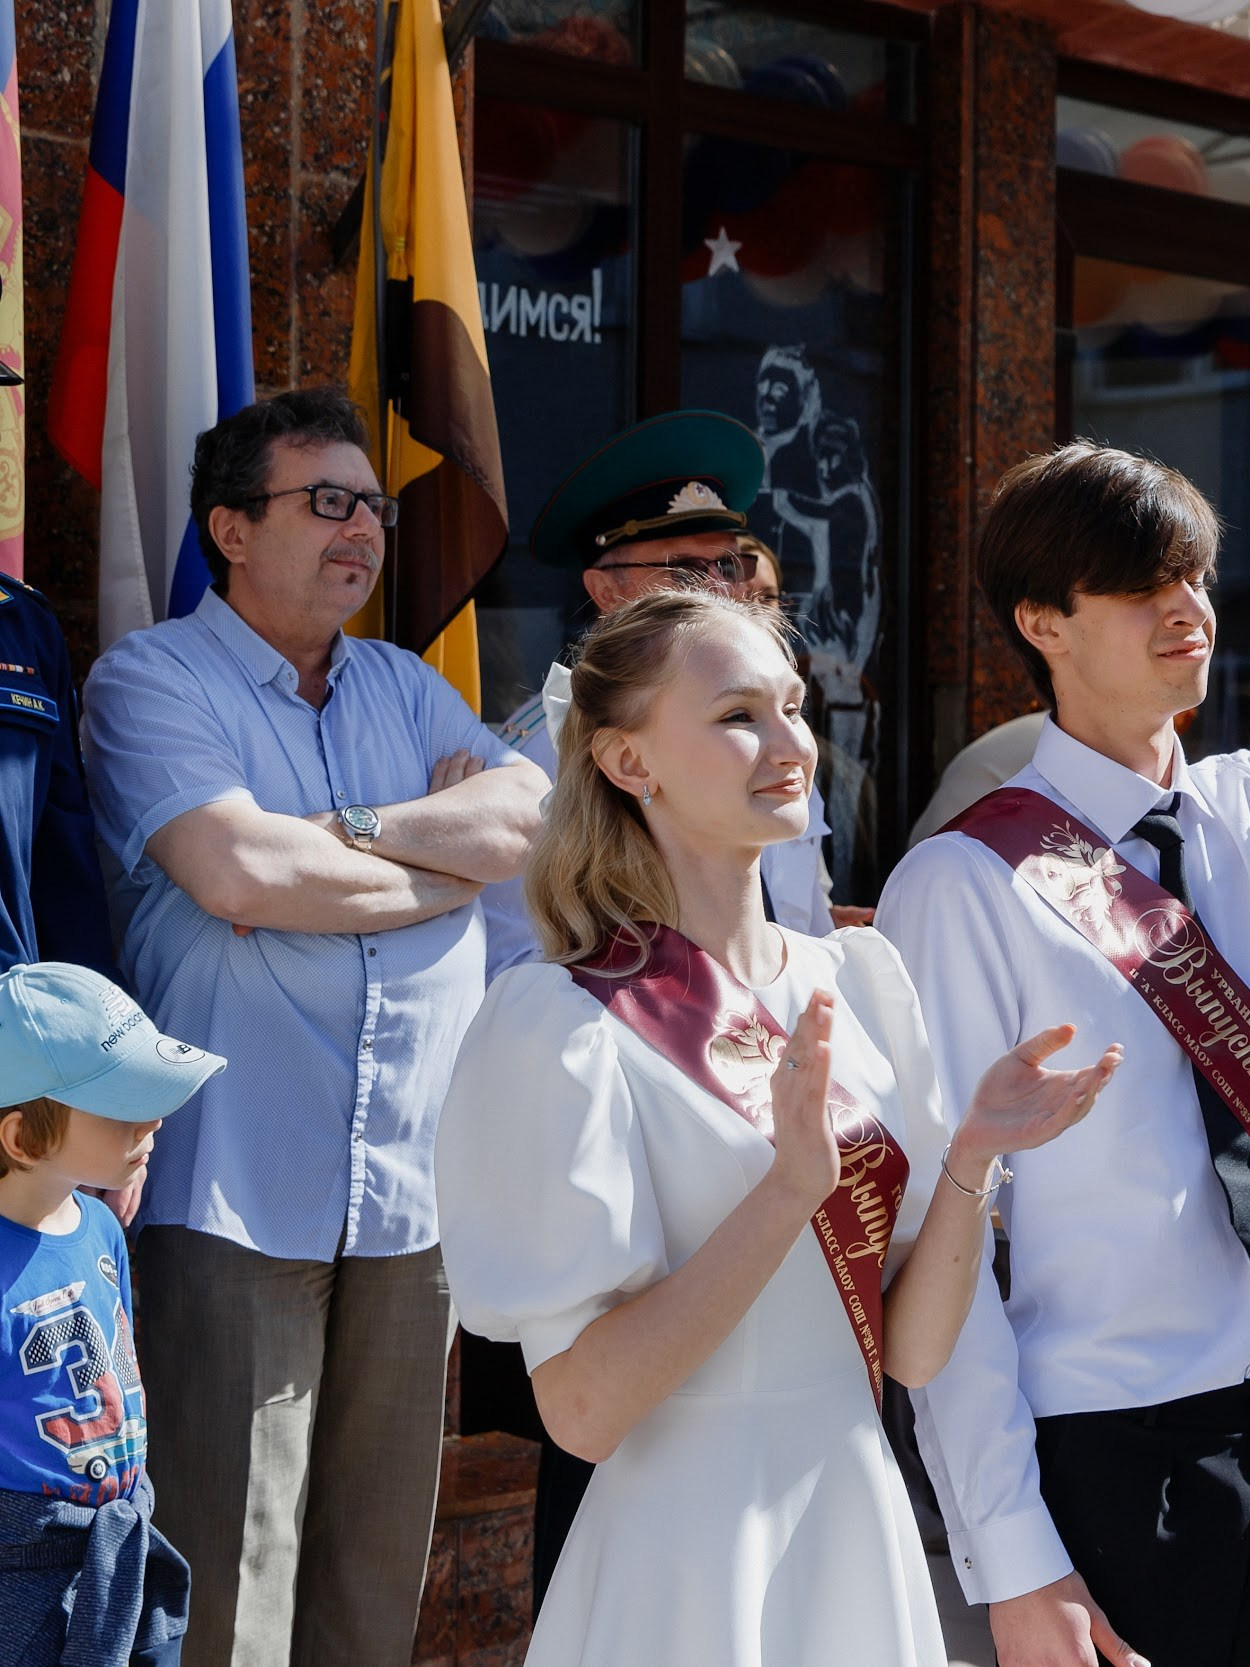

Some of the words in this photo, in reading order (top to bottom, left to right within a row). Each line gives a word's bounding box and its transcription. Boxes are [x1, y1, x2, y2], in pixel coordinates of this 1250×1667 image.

[101, 1025, 125, 1052] new
[122, 1011, 147, 1032] balan
[1152, 995, 1186, 1035] КЛАСС
[1184, 1033, 1213, 1067] МАОУ
[1212, 1069, 1234, 1099] СОШ
[814, 1209, 841, 1256] КЛАСС
[833, 1255, 856, 1291] МАОУ
[848, 1294, 869, 1326] СОШ
[858, 1323, 876, 1351] №33
